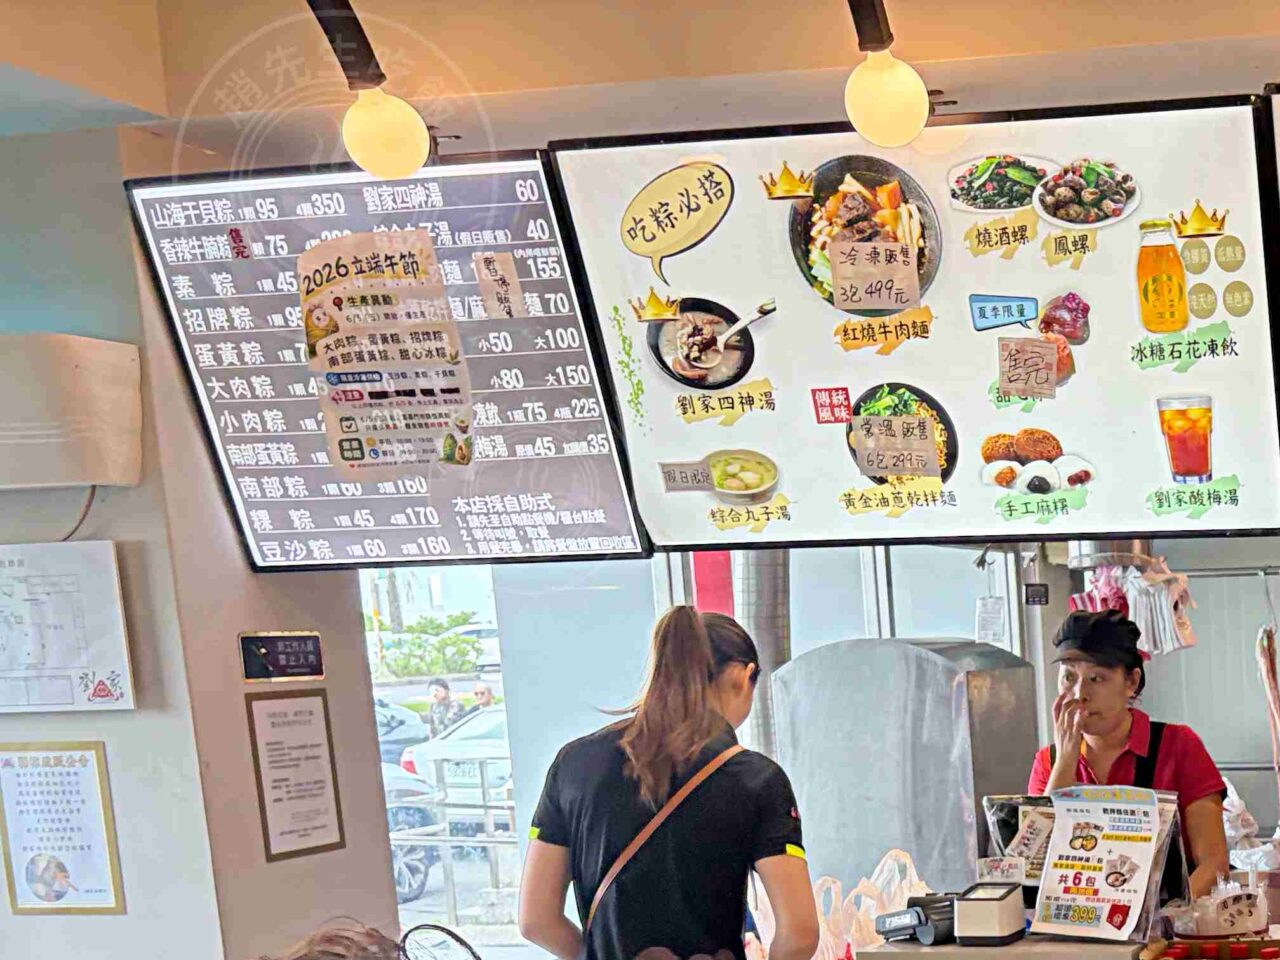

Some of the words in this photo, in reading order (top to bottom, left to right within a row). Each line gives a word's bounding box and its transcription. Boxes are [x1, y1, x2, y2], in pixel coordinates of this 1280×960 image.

[363, 182, 443, 212] 劉家四神湯
[516, 179, 540, 202] 60
[626, 168, 727, 244] 吃粽必搭
[151, 200, 234, 228] 山海干貝粽
[527, 218, 550, 241] 40
[975, 224, 1031, 248] 燒酒螺
[839, 245, 911, 267] 冷凍販售
[1053, 233, 1090, 256] 鳳螺
[527, 256, 562, 279] 155
[547, 293, 570, 315] 70
[976, 302, 1028, 320] 夏季限量
[183, 305, 255, 333] 招牌粽
[841, 321, 930, 343] 紅燒牛肉麵
[194, 341, 266, 367] 蛋黃粽
[1130, 336, 1239, 363] 冰糖石花凍飲
[207, 374, 280, 401] 大肉粽
[814, 389, 848, 406] 傳統
[677, 390, 776, 416] 劉家四神湯
[819, 406, 851, 422] 風味
[220, 408, 288, 433] 小肉粽
[227, 442, 300, 467] 南部蛋黃粽
[237, 475, 309, 499] 南部粽
[452, 493, 556, 514] 本店採自助式
[260, 538, 334, 562] 豆沙粽
